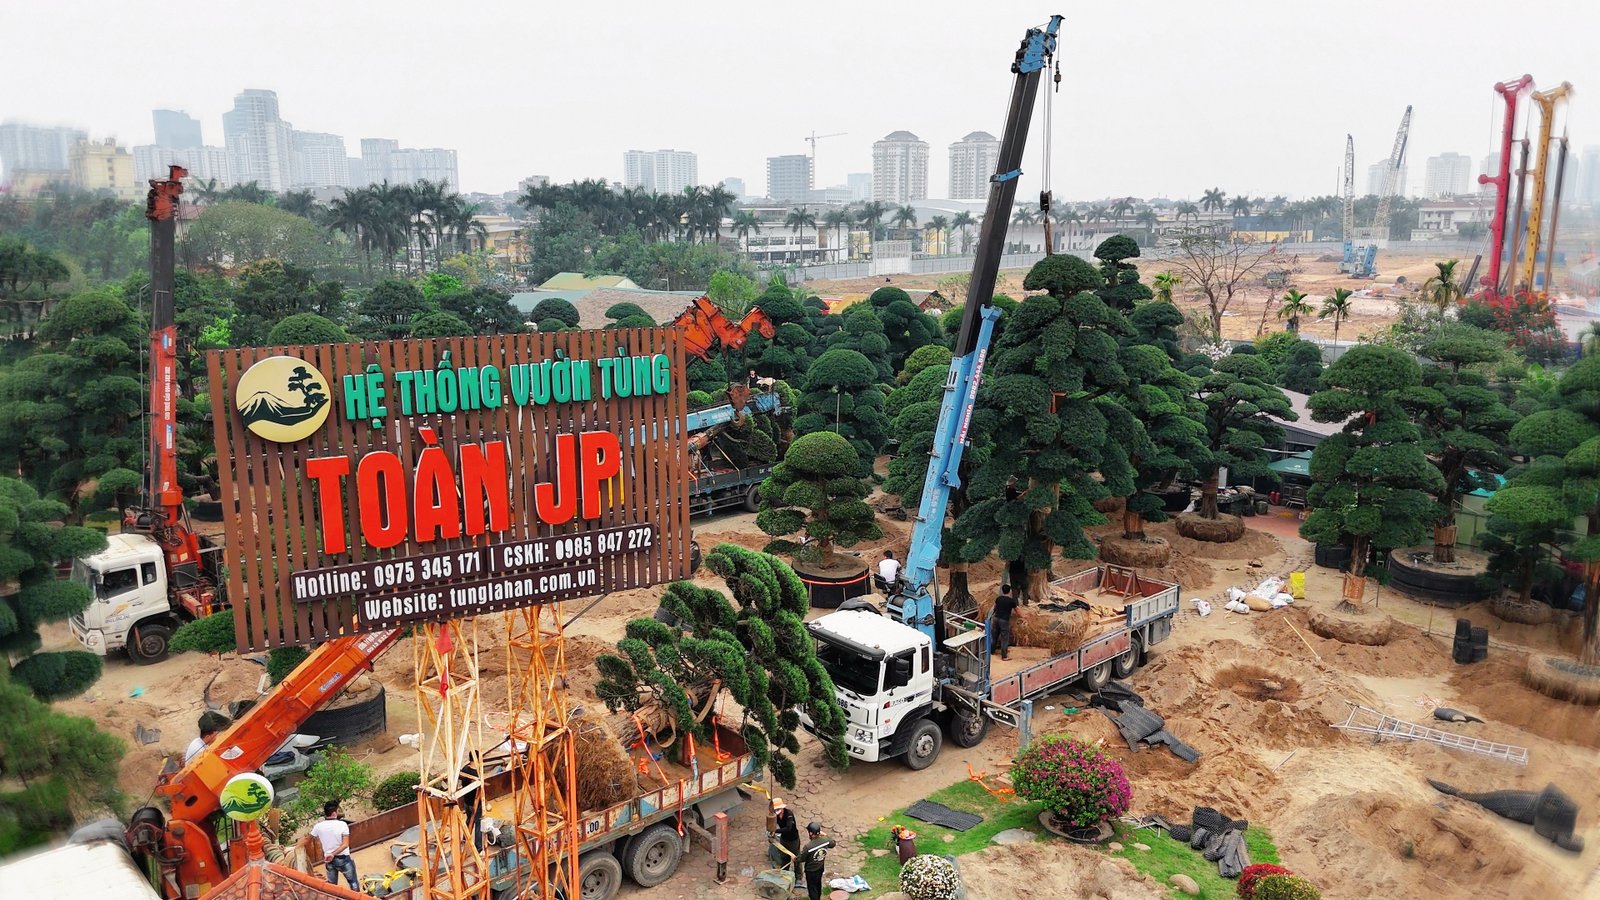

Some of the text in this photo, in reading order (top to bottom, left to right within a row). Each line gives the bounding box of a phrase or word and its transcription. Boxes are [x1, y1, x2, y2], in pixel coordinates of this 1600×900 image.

[343, 347, 670, 428] HỆ THỐNG VƯỜN TÙNG
[306, 428, 620, 554] TOÀN JP
[295, 528, 652, 600] Hotline: 0975 345 171 CSKH: 0985 847 272
[365, 568, 595, 620] Website: tunglahan.com.vn
